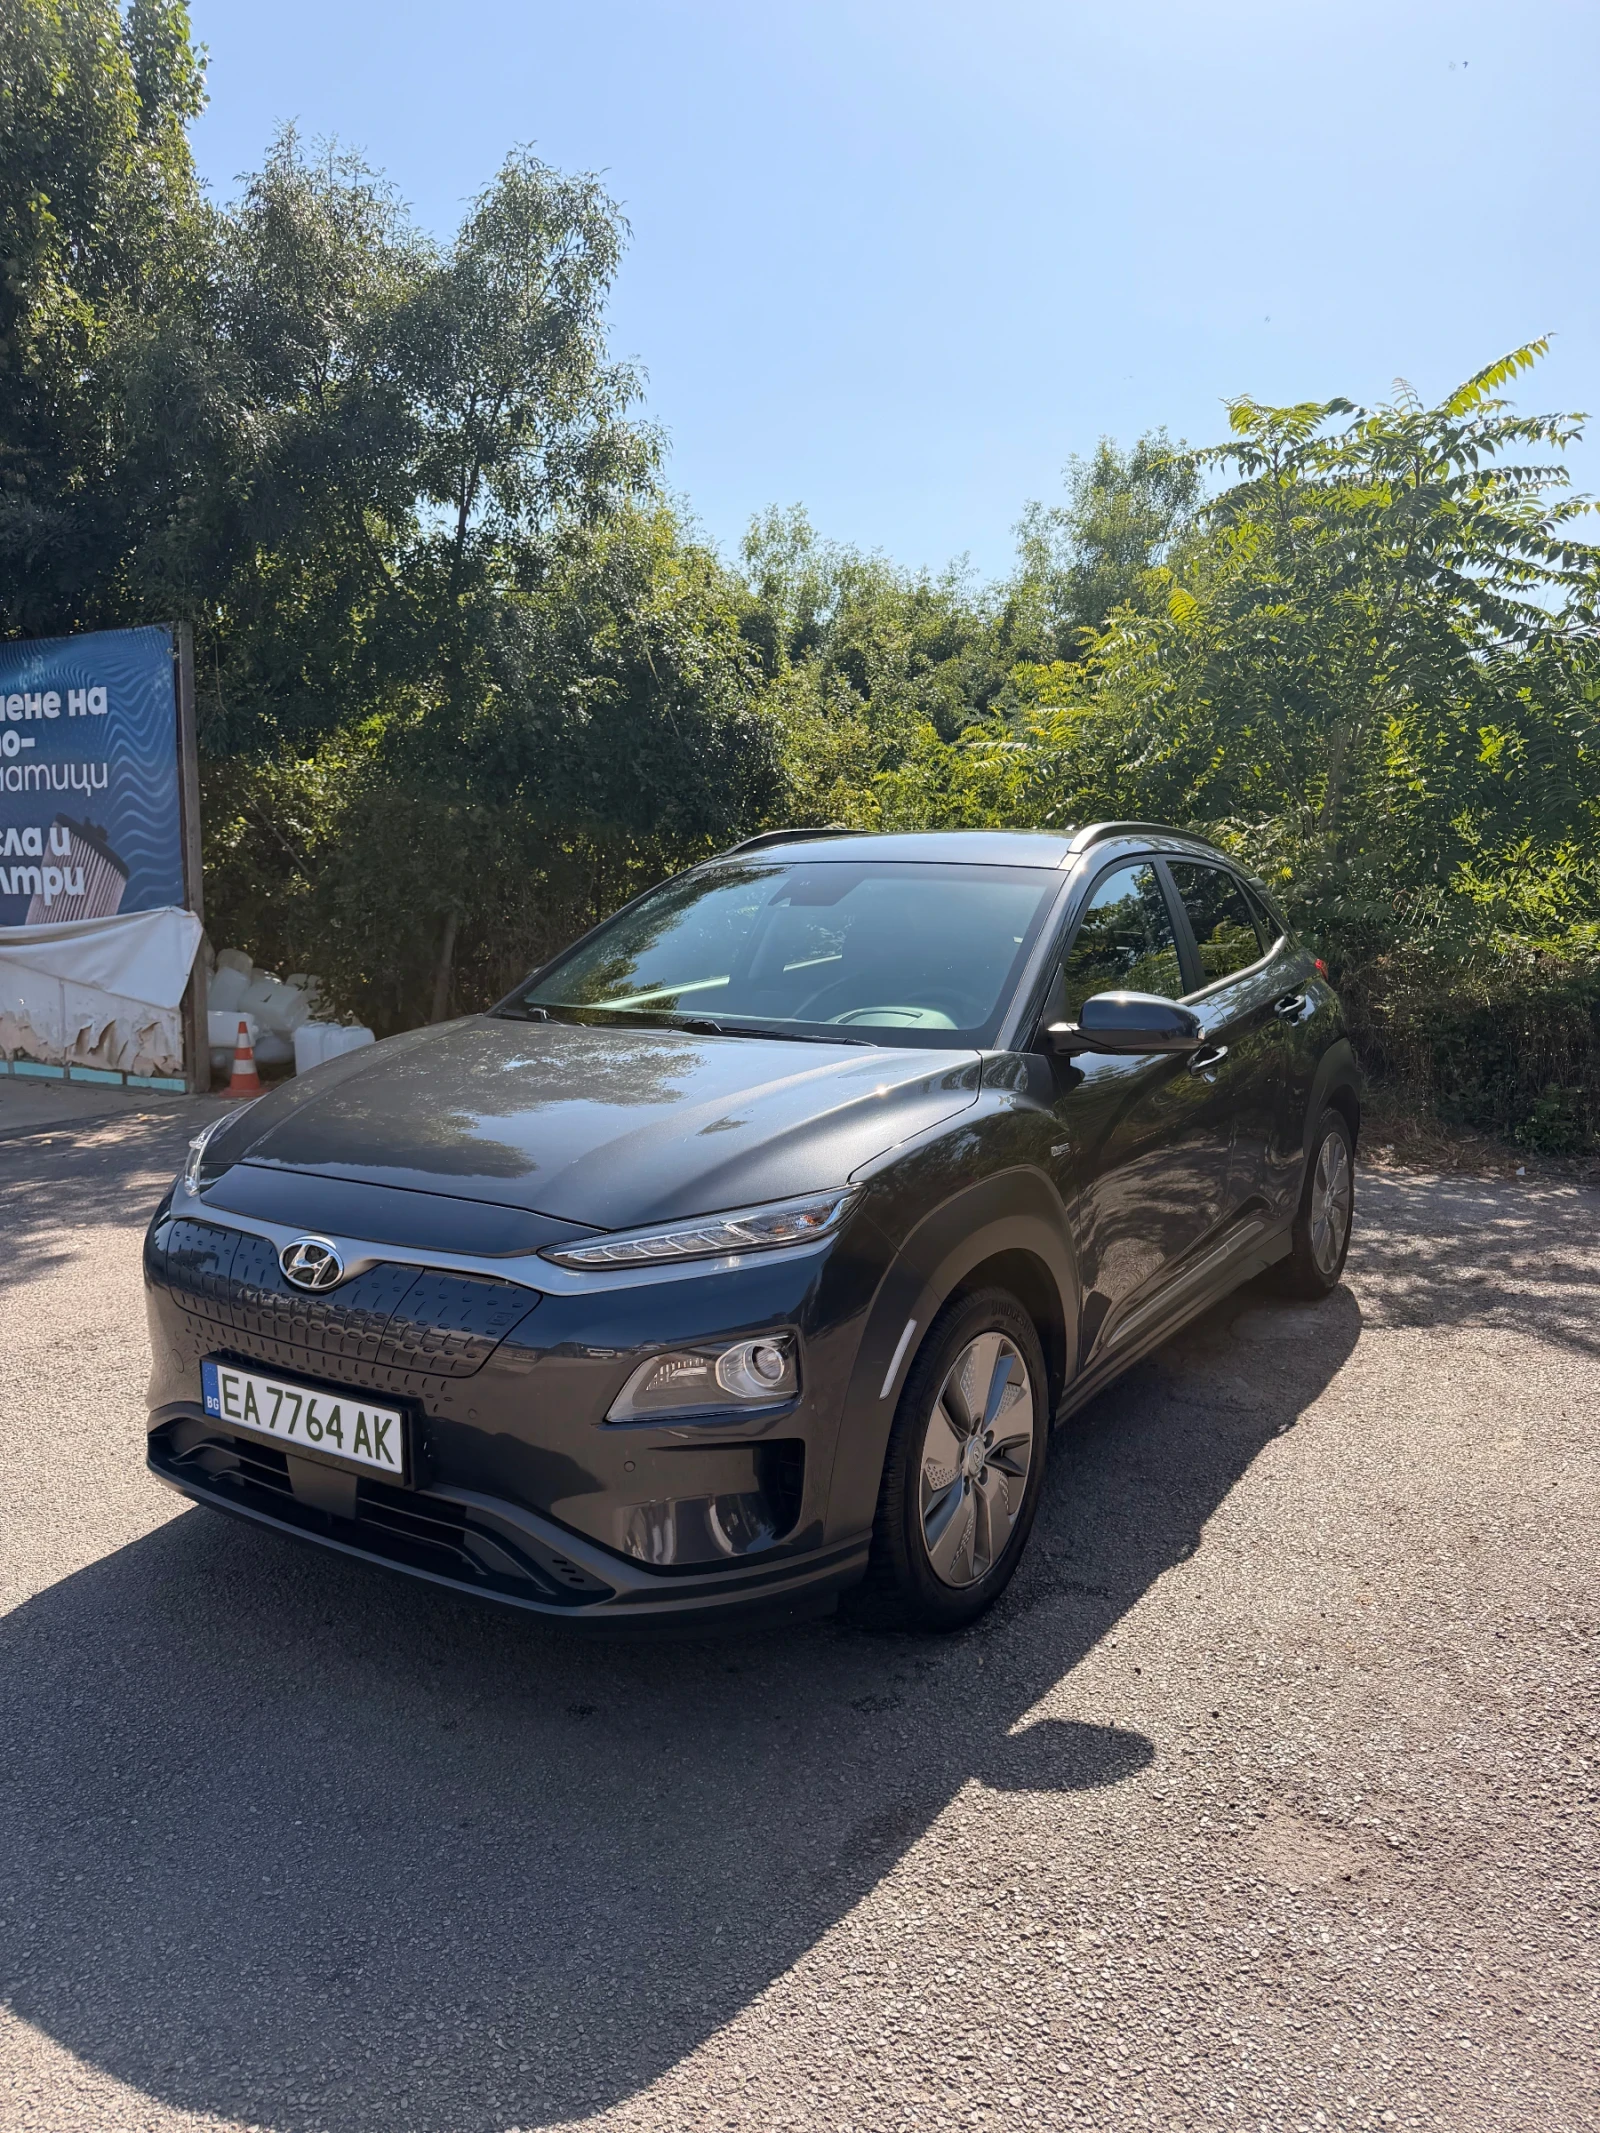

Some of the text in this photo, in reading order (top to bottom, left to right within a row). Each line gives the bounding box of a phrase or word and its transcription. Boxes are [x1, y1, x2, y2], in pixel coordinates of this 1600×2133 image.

[0, 687, 108, 721] ене на
[0, 730, 35, 757] о-
[0, 763, 108, 796] атици
[0, 827, 72, 857] ла и
[206, 1395, 220, 1410] BG
[222, 1374, 395, 1465] EA 7764 AK
